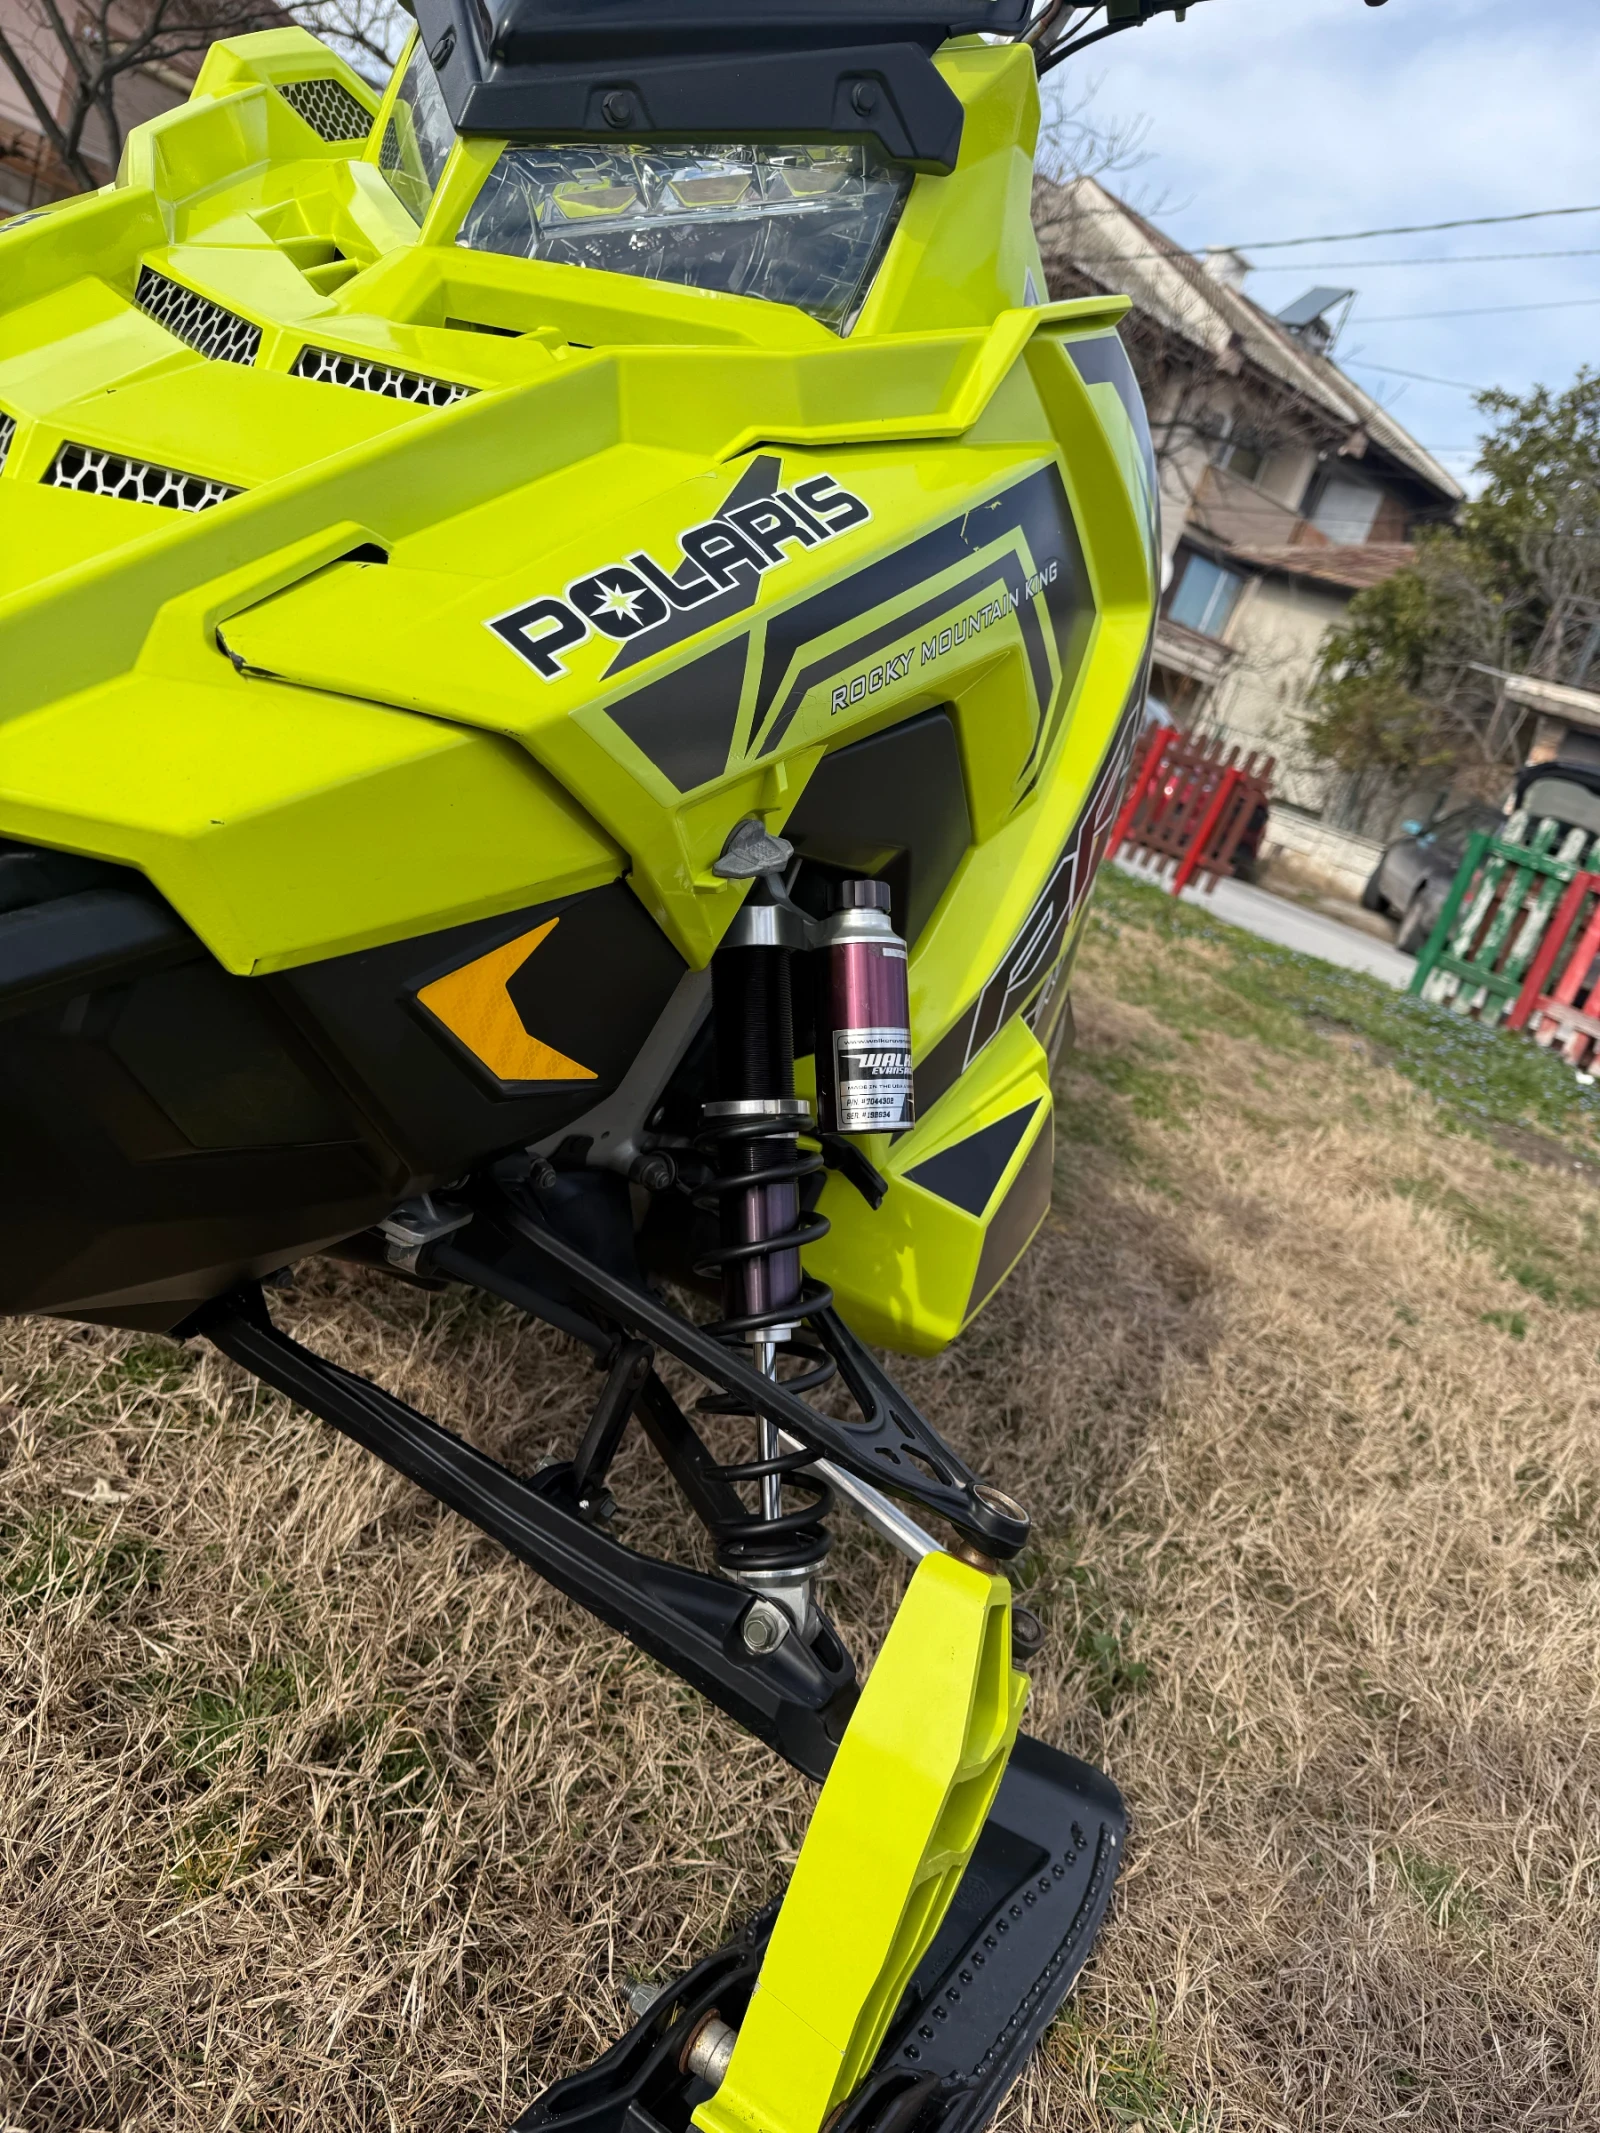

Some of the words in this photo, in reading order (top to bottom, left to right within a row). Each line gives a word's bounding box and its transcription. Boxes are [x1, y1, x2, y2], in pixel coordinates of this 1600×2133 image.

[484, 472, 873, 683] POLARIS
[830, 647, 915, 716] ROCKY
[921, 588, 1019, 667] MOUNTAIN
[1025, 561, 1058, 601] KING
